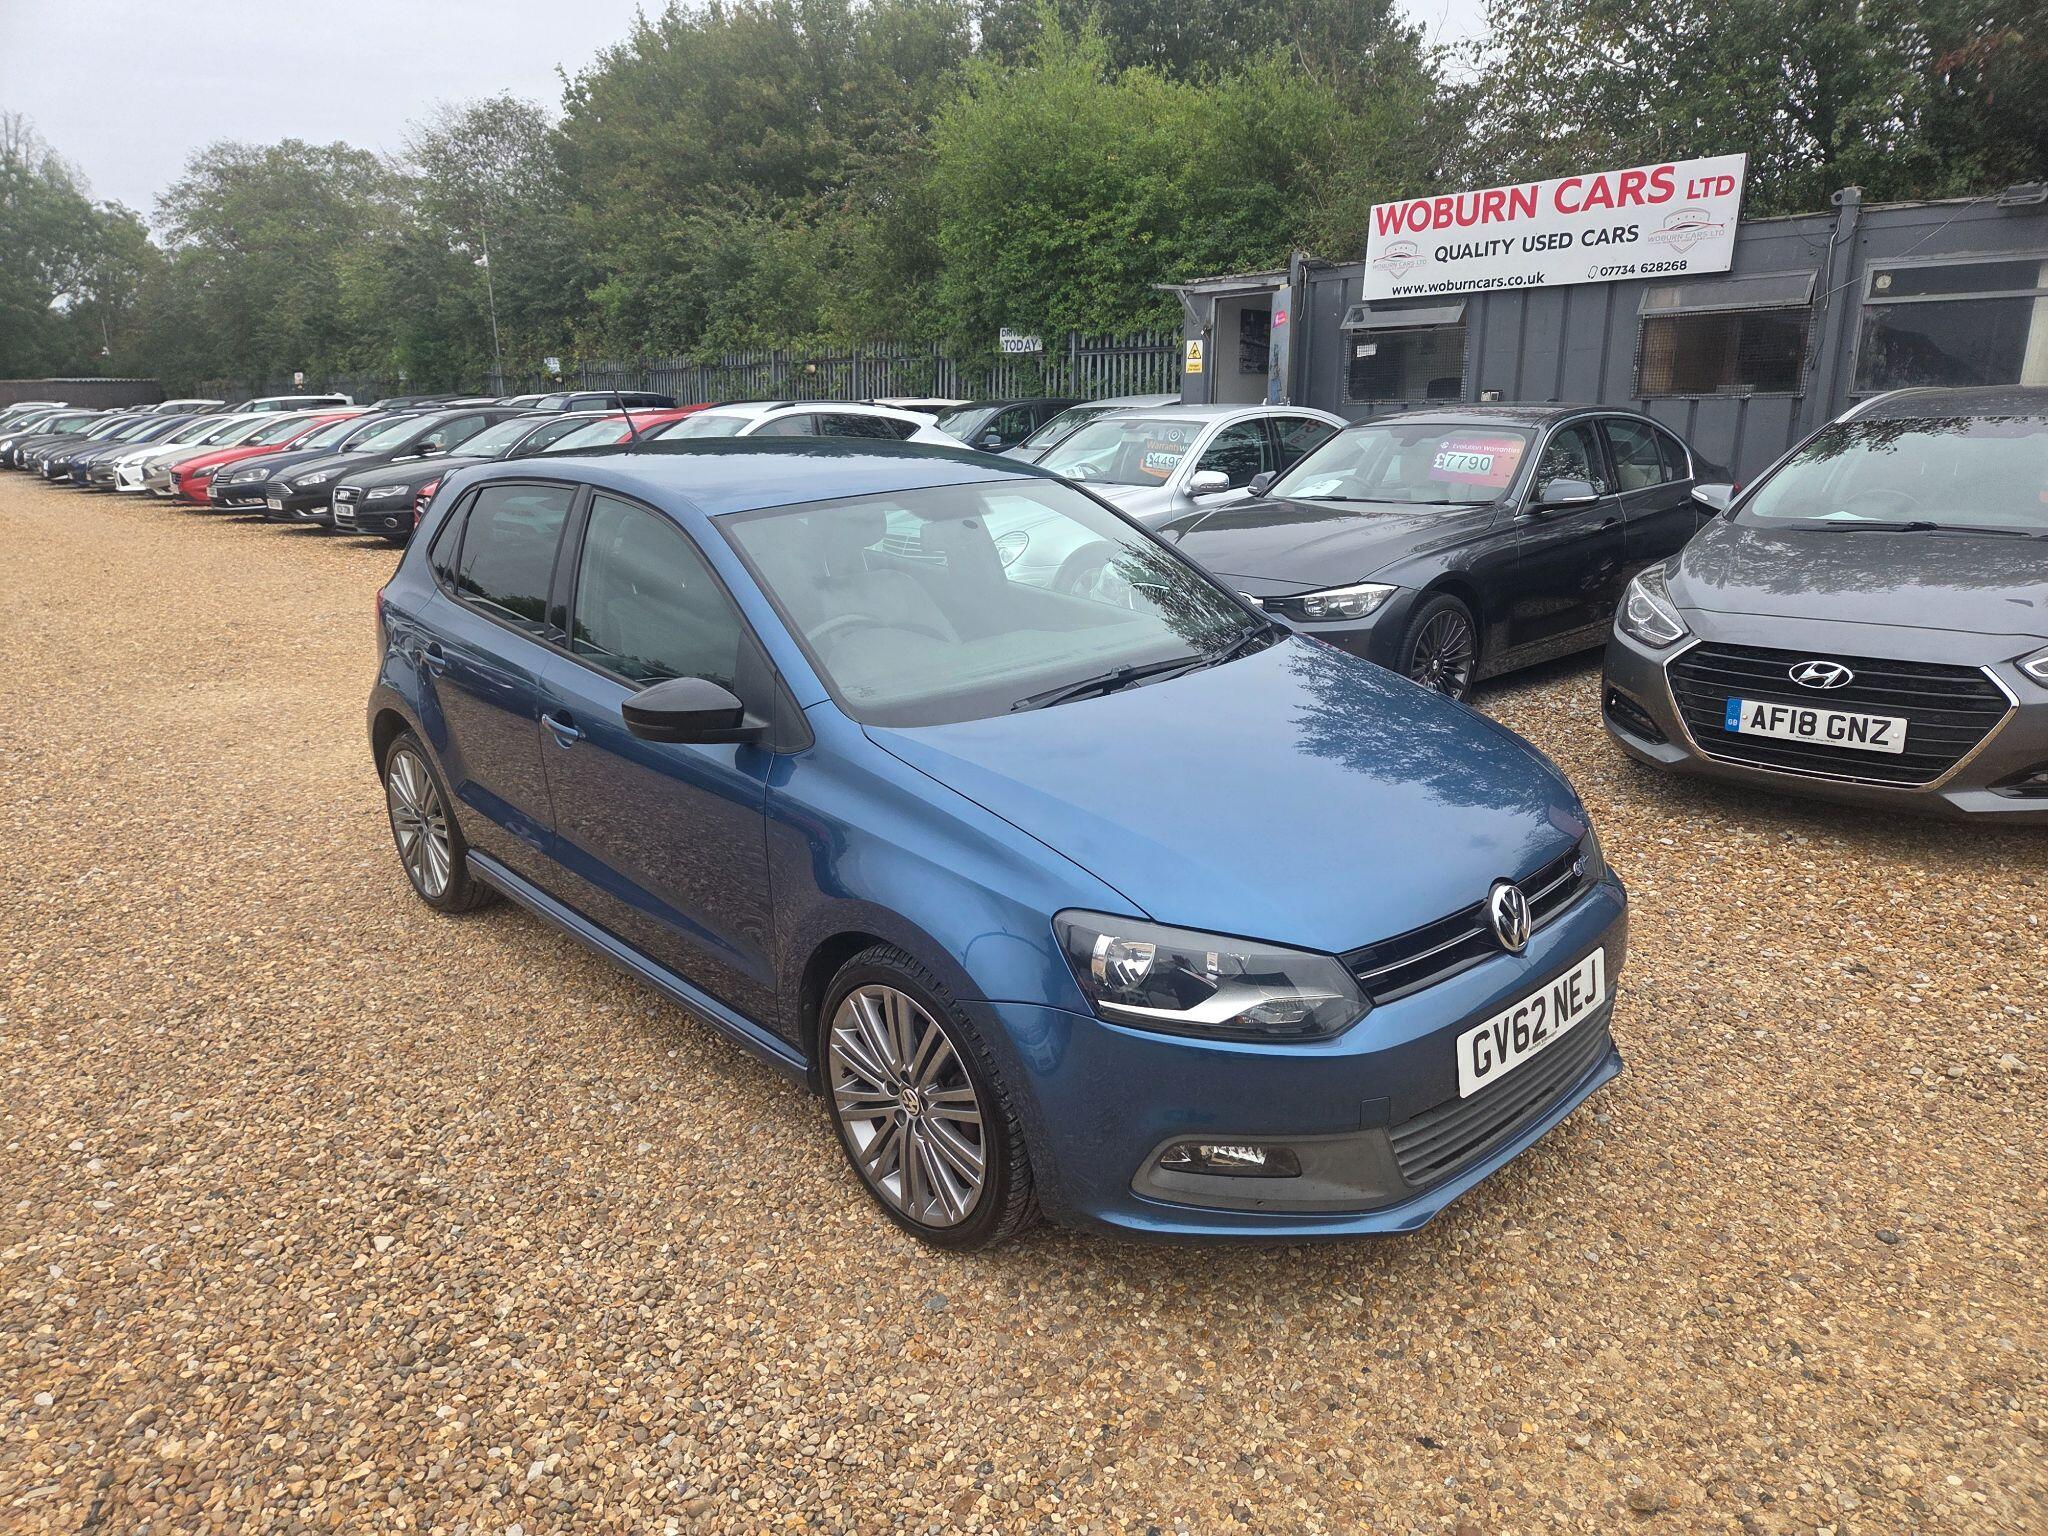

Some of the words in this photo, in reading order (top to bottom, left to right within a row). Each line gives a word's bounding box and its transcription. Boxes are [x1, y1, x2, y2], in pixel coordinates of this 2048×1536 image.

[1375, 185, 1540, 236] WOBURN
[1553, 166, 1677, 214] CARS
[1687, 175, 1735, 201] LTD
[1434, 238, 1516, 263] QUALITY
[1522, 232, 1573, 251] USED
[1581, 224, 1640, 246] CARS
[1600, 264, 1636, 277] 07734
[1640, 259, 1688, 274] 628268
[1392, 271, 1545, 296] www.woburncars.co.uk
[1004, 339, 1039, 351] TODAY
[1453, 443, 1482, 451] Evolution
[1483, 445, 1520, 454] Warranties
[1433, 452, 1491, 471] £7790
[1727, 718, 1738, 726] GB
[1750, 705, 1818, 736] AF18
[1827, 714, 1892, 746] GNZ
[1473, 996, 1547, 1078] GV62
[1553, 959, 1596, 1029] NEJ
